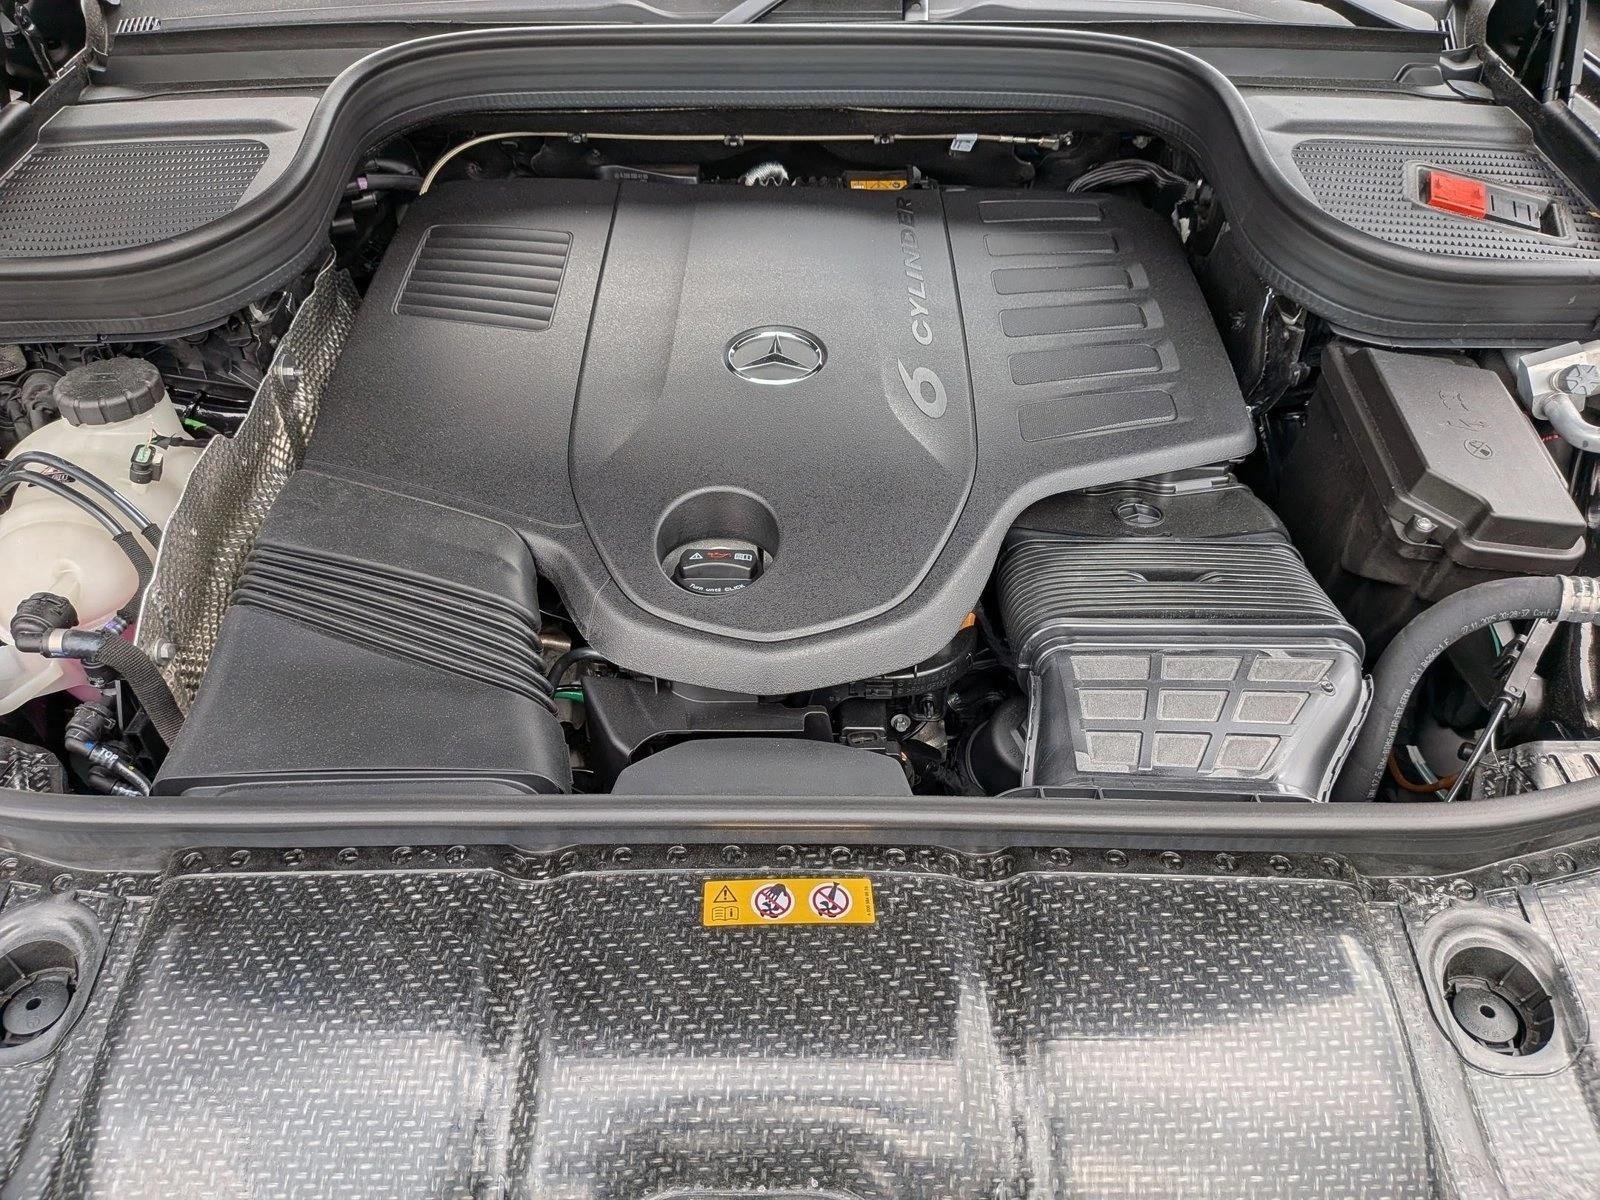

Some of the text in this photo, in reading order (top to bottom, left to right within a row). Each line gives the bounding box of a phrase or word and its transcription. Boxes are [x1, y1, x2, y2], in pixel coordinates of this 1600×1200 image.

[896, 196, 948, 420] 6 CYLINDER
[689, 583, 704, 591] Turn
[724, 584, 746, 592] CLICK
[100, 747, 119, 762] TOP
